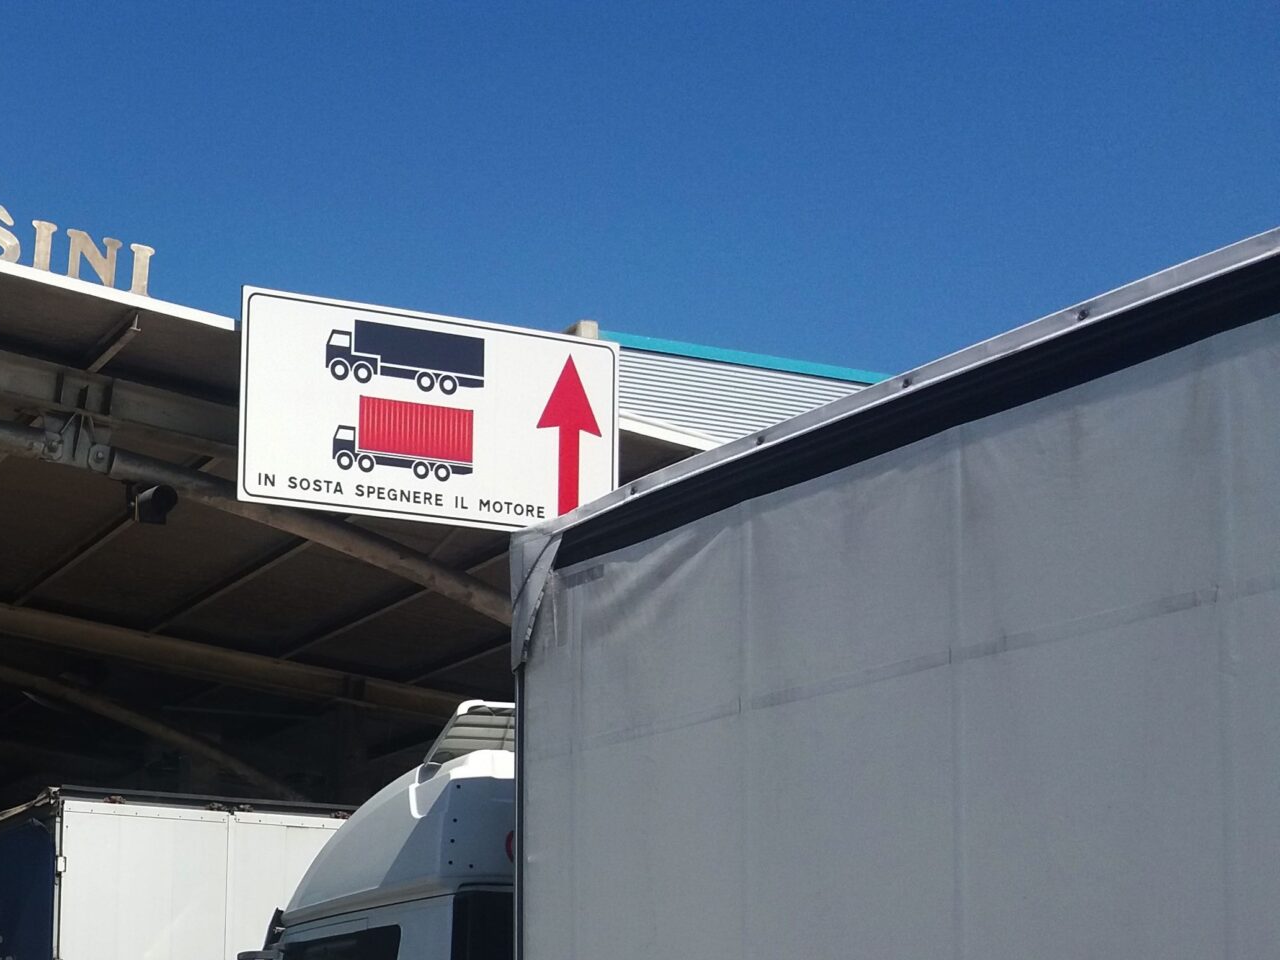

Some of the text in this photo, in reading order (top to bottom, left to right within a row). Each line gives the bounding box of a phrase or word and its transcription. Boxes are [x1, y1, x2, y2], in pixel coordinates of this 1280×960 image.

[257, 472, 546, 519] IN SOSTA SPEGNERE IL MOTORE
